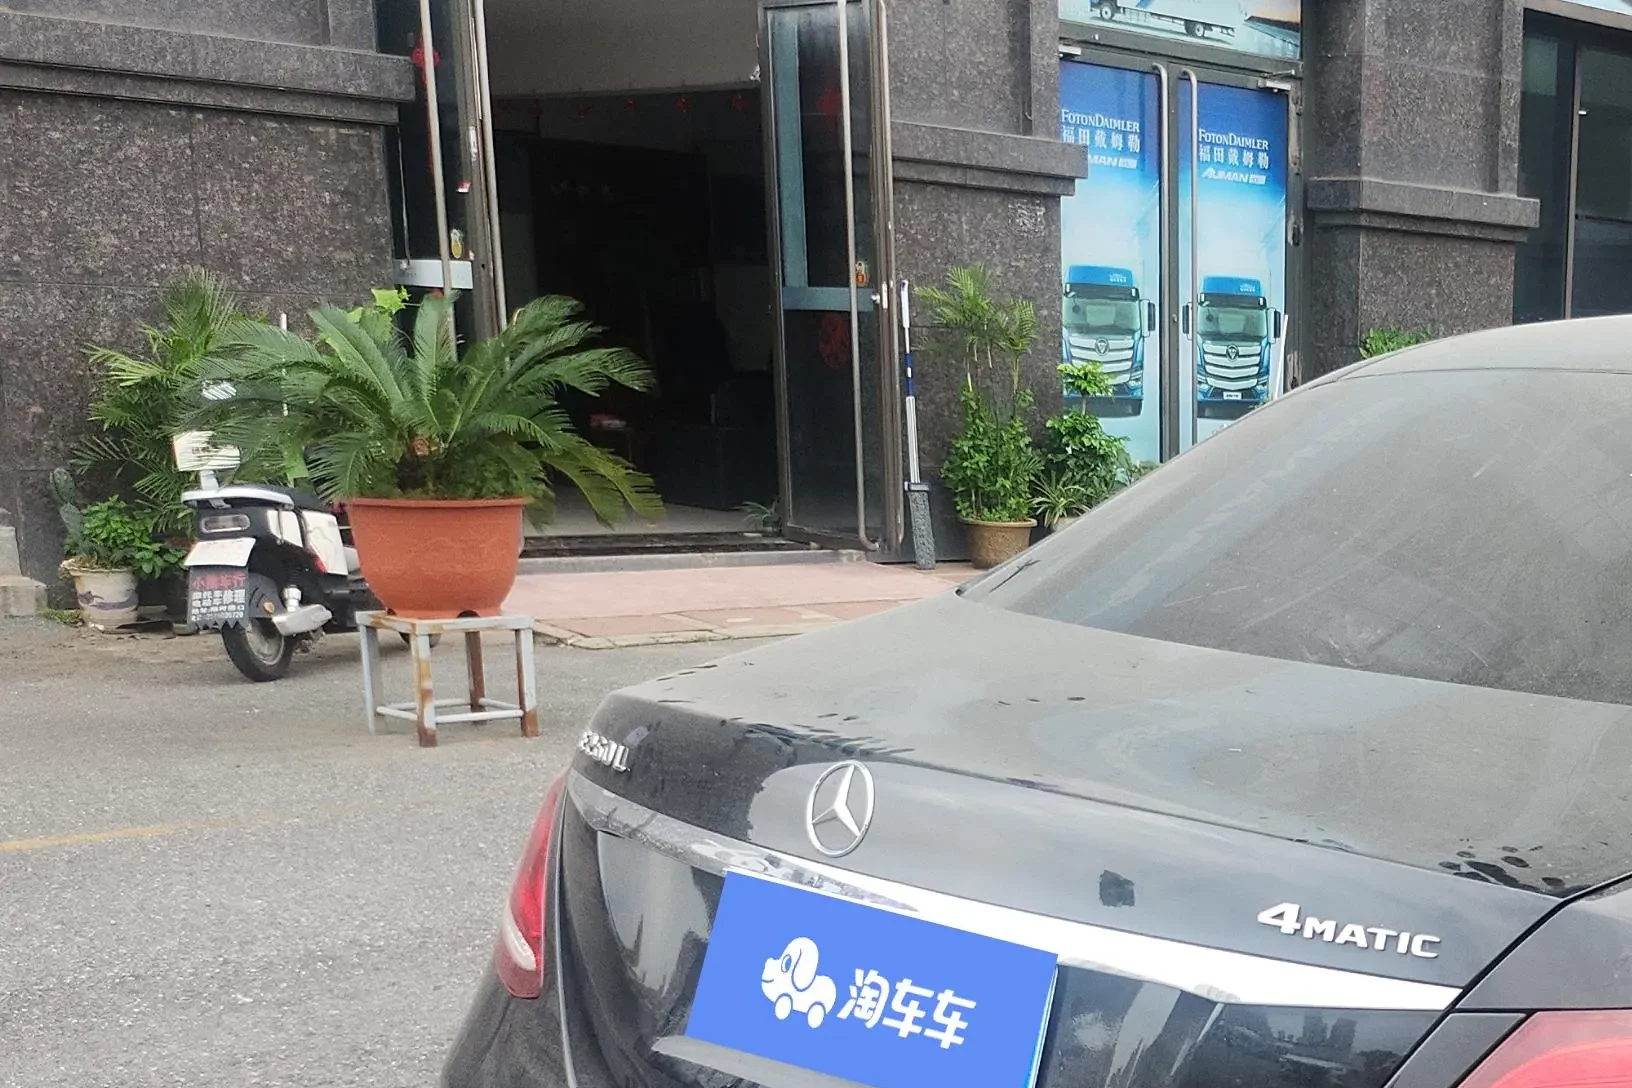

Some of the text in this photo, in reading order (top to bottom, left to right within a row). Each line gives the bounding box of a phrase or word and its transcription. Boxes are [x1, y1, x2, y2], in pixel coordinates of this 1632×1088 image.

[1062, 126, 1140, 153] 福田戴姆勒
[1088, 154, 1119, 169] MAN
[1199, 145, 1269, 170] 福田戴姆勒
[1257, 902, 1441, 958] 4MATIC
